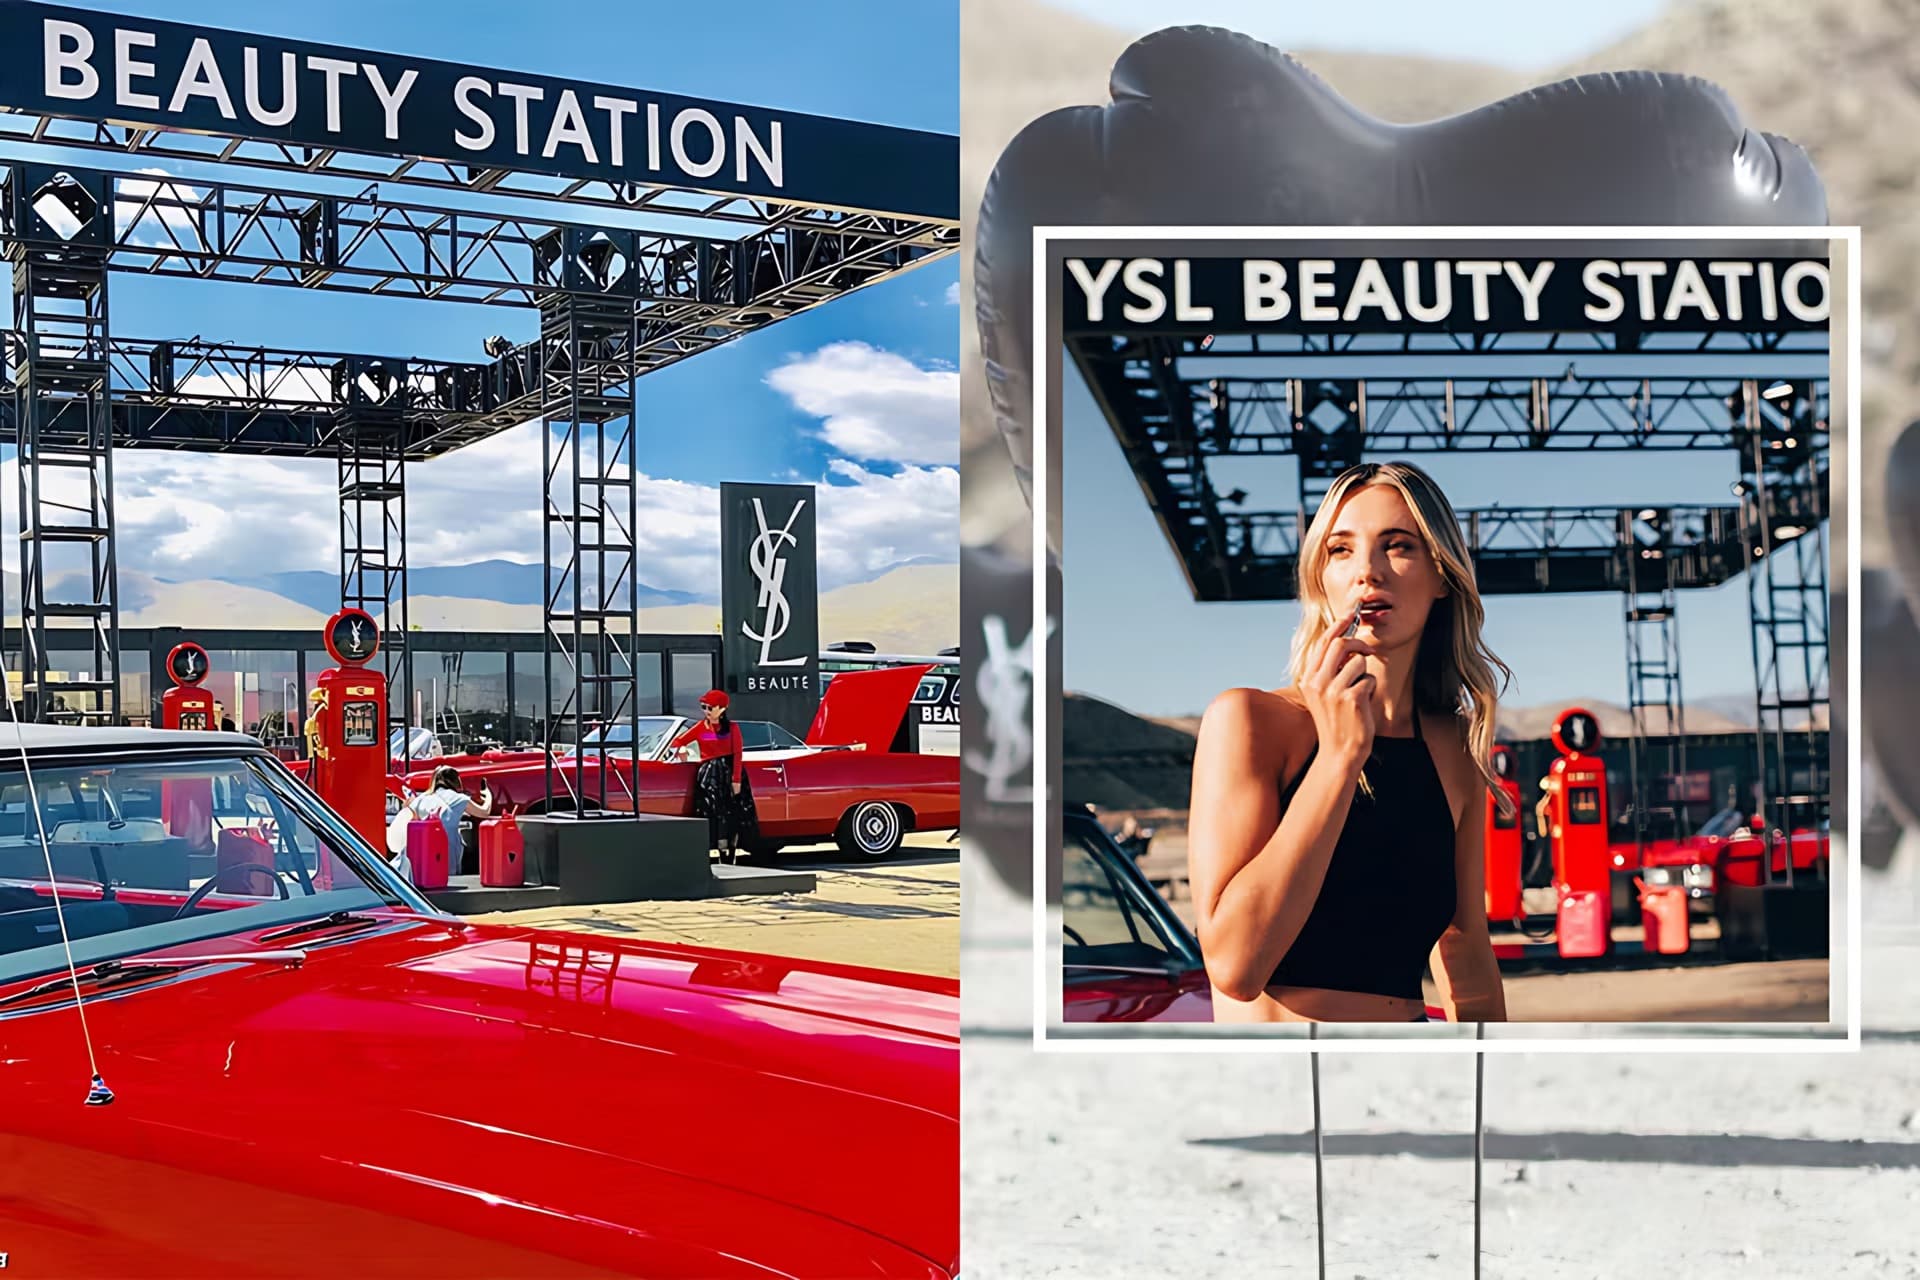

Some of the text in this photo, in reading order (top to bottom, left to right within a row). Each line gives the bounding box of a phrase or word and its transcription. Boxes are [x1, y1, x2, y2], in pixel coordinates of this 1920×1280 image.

[43, 18, 784, 188] BEAUTY STATION
[1066, 258, 1830, 323] YSL BEAUTY STATIO
